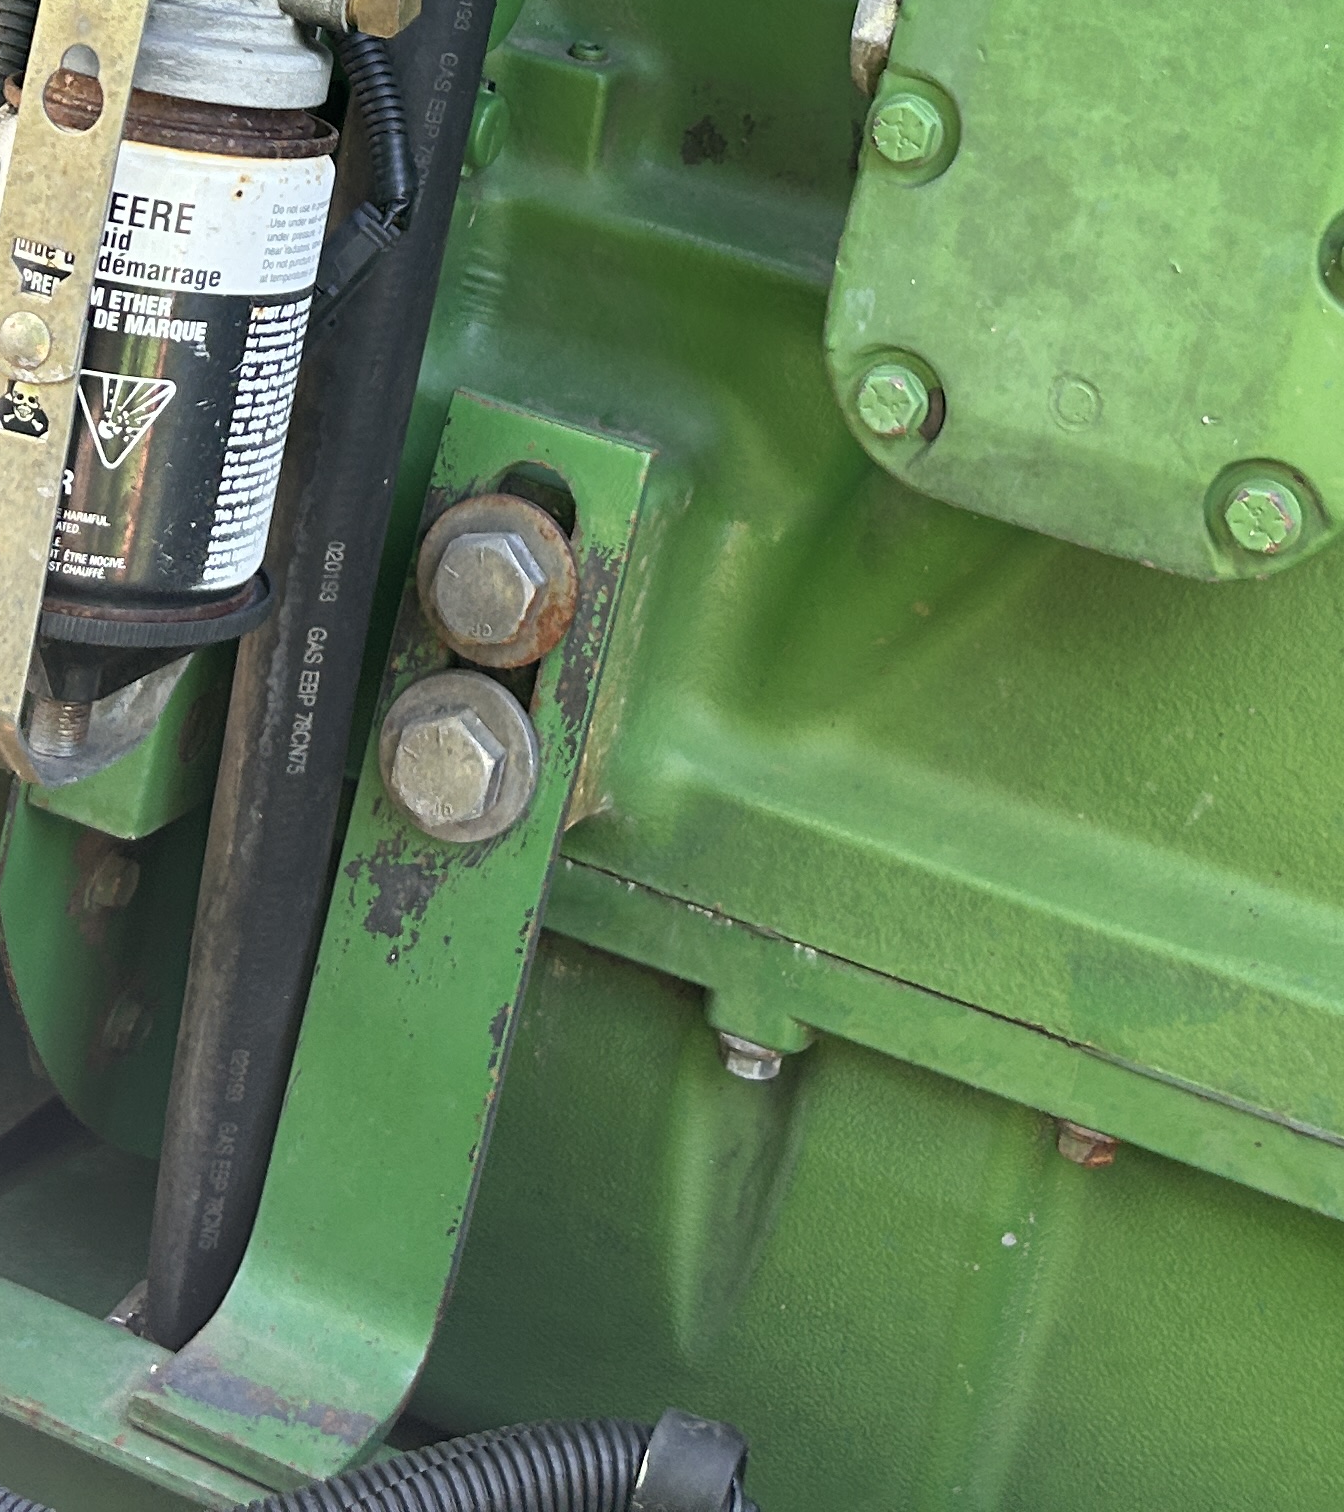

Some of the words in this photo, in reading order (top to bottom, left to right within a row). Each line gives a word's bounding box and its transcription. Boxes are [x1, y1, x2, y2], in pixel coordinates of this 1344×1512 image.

[431, 49, 460, 94] GAS
[108, 192, 196, 235] EERE
[98, 251, 221, 291] démarrage
[108, 289, 174, 317] ETHER
[93, 308, 120, 331] DE
[124, 314, 208, 343] MARQUE
[56, 521, 81, 535] ATED.
[63, 510, 111, 527] HARMFUL.
[63, 549, 88, 564] ÊTRE
[90, 554, 126, 569] NOCIVE.
[63, 563, 106, 579] CHAUFFÉ.
[317, 539, 346, 603] 020193
[302, 625, 328, 665] GAS
